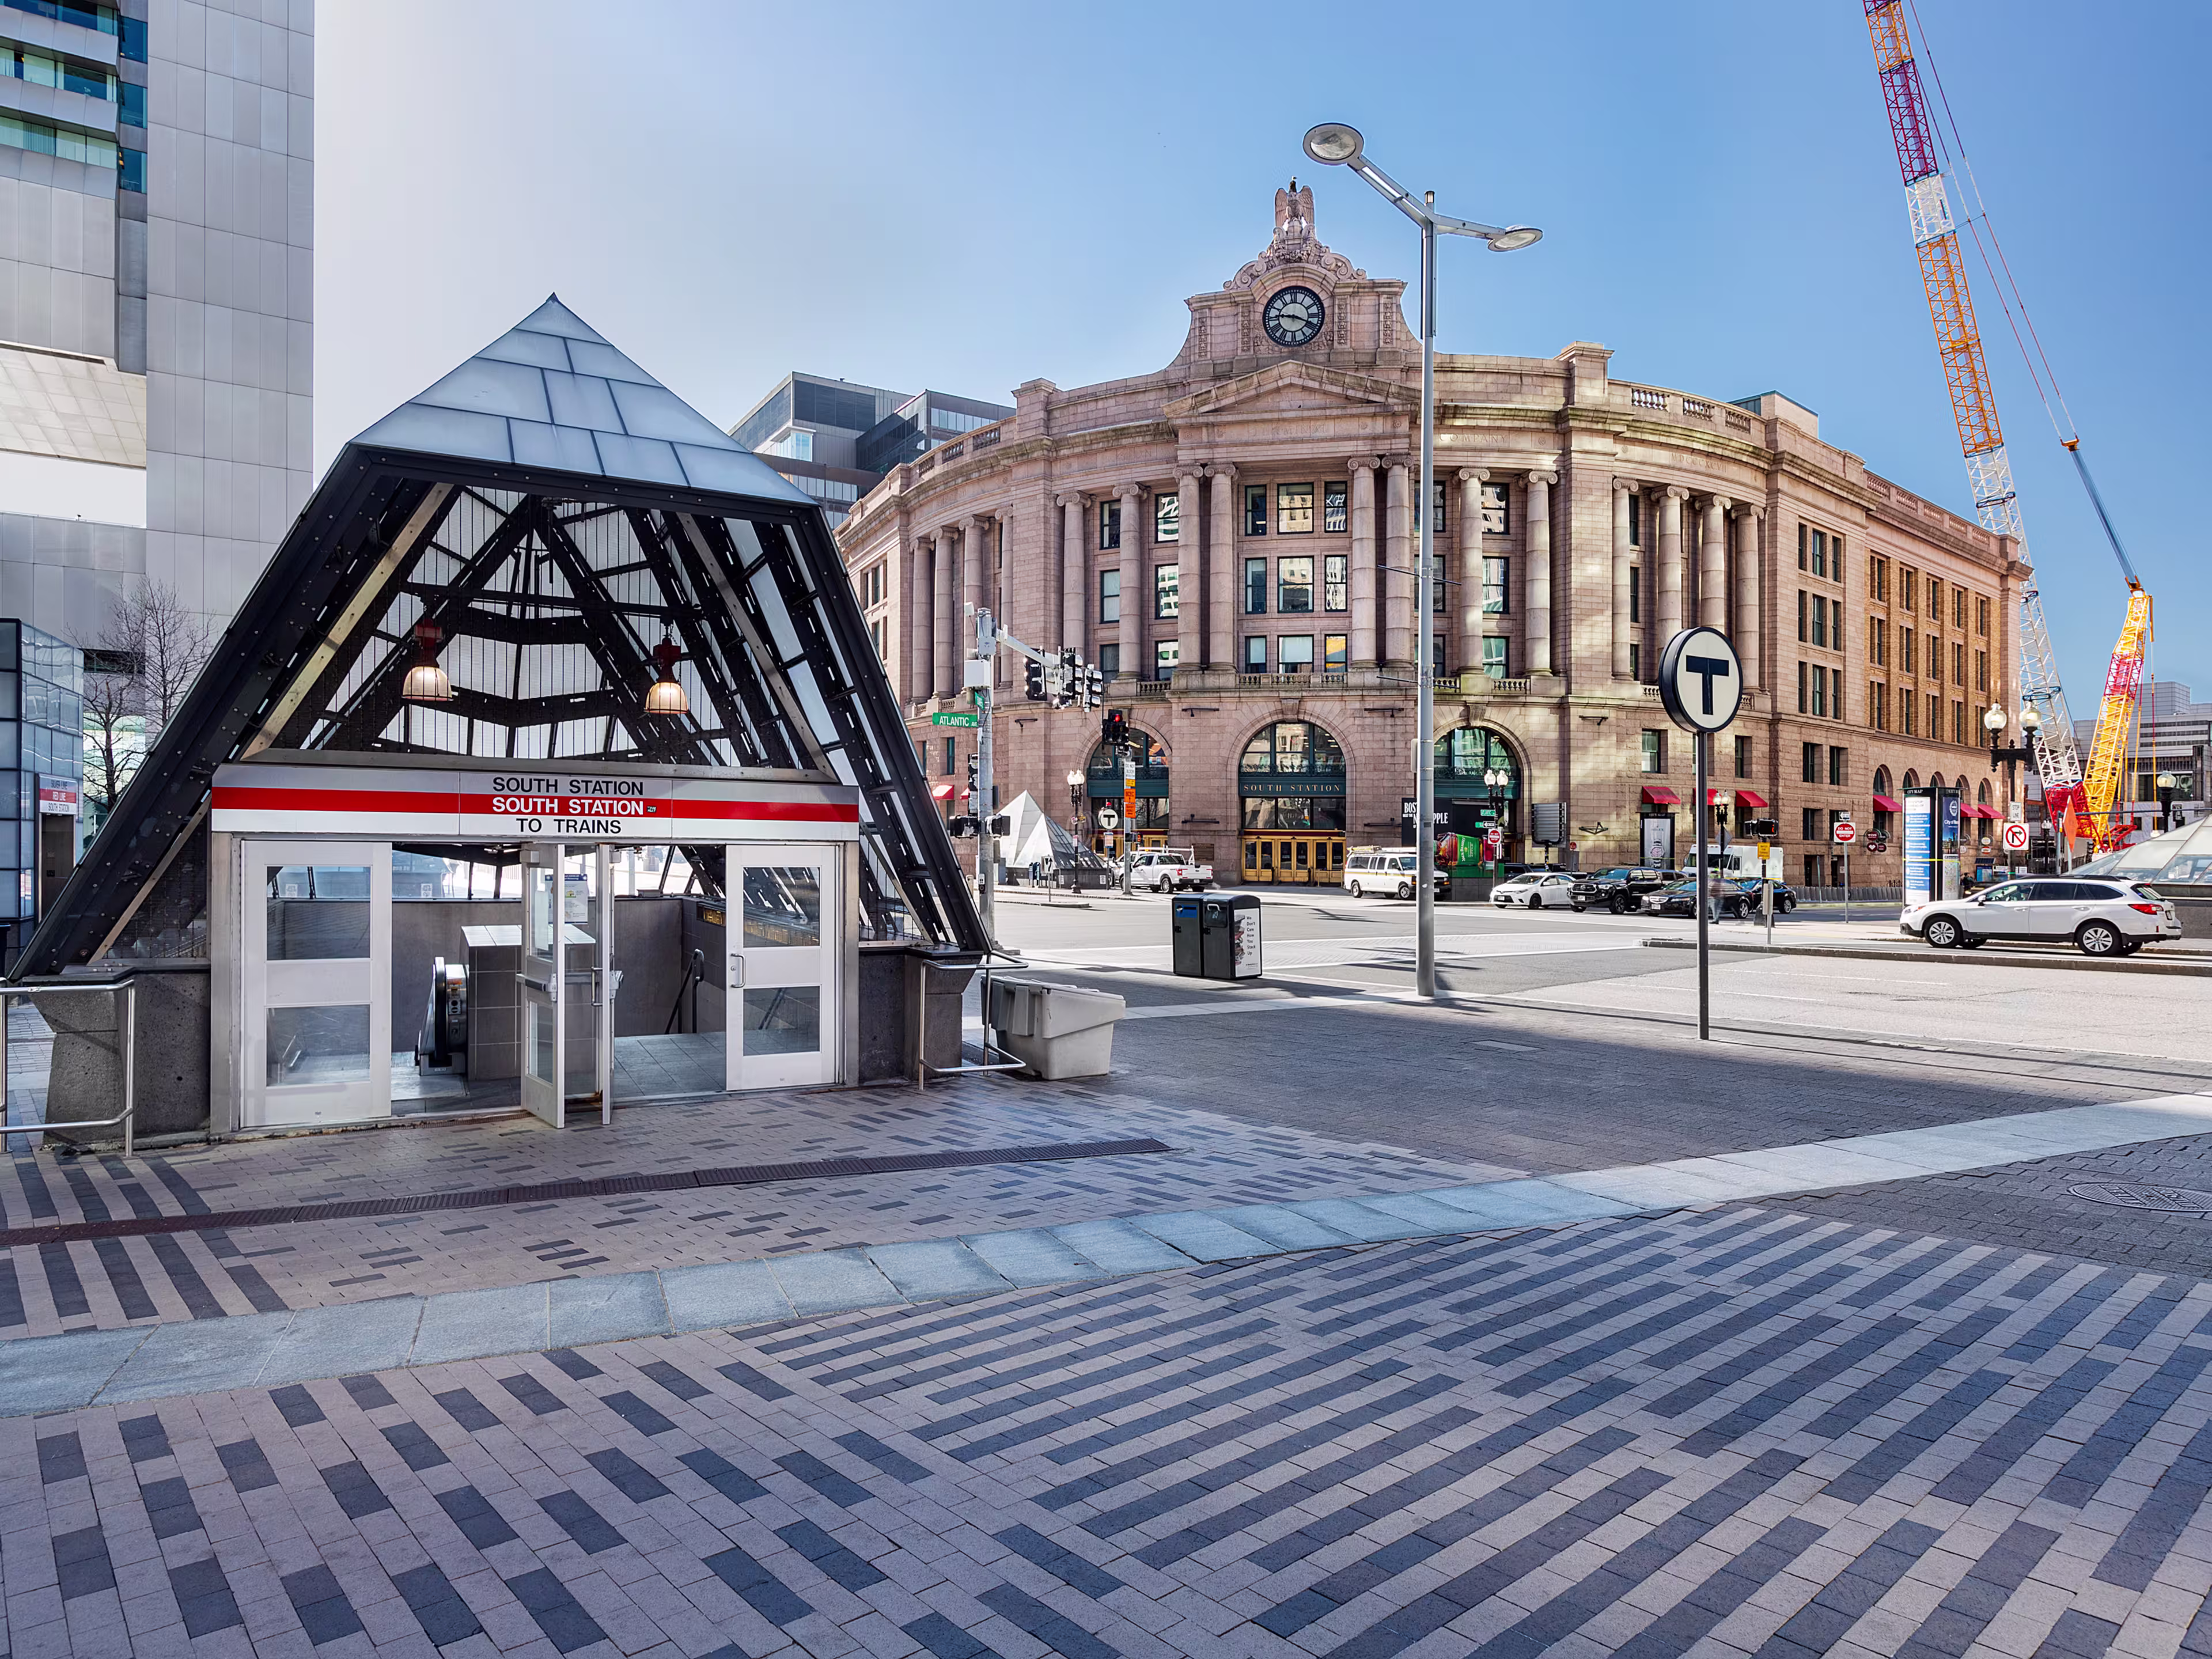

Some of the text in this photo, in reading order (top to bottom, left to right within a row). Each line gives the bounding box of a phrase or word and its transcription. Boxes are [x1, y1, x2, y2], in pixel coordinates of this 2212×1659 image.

[1440, 433, 1508, 444] COMPANY
[1685, 655, 1729, 715] T
[940, 715, 969, 726] ATLANTIC
[493, 777, 643, 796] SOUTH STATION
[493, 797, 558, 813] SOUTH
[569, 798, 643, 815] STATION
[1404, 802, 1417, 813] BOS
[1103, 815, 1115, 826] T
[1433, 813, 1448, 824] PPLE
[516, 818, 622, 834] TO TRAINS
